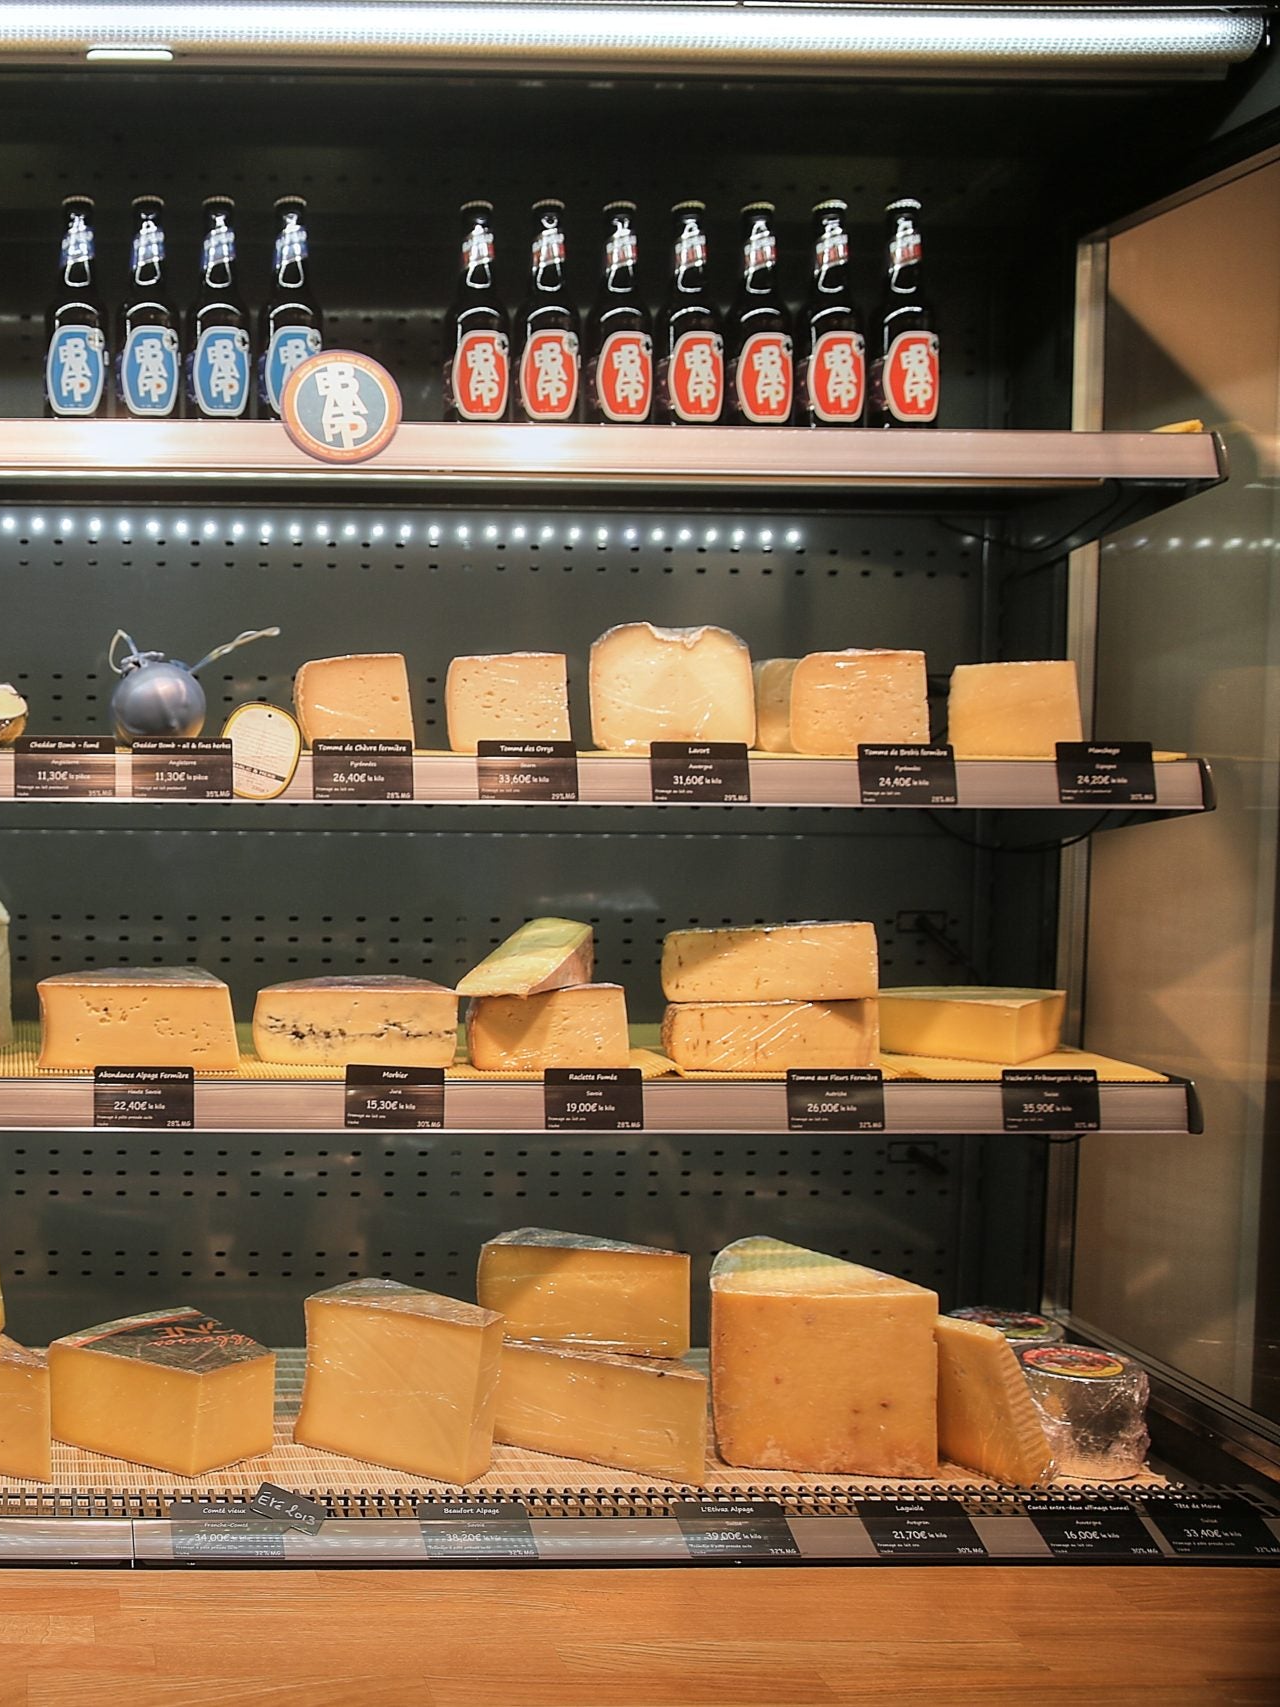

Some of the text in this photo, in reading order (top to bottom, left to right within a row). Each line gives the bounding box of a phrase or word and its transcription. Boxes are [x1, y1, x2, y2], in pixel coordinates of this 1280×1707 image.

[84, 741, 99, 749] fumé
[378, 744, 406, 752] fermière
[536, 745, 553, 753] Orrys
[38, 771, 68, 781] 11,30€
[155, 772, 185, 781] 11,30€
[333, 773, 366, 783] 26,40€
[499, 775, 531, 785] 33,60€
[673, 776, 704, 785] 31,60€
[1077, 776, 1110, 785] 24,20€
[879, 778, 911, 788] 24,40€
[136, 1072, 158, 1080] Alpage
[160, 1071, 189, 1079] Fermière
[114, 1101, 147, 1110] 22,40€
[367, 1100, 398, 1110] 15,30€
[567, 1103, 597, 1112] 19,00€
[808, 1104, 839, 1113] 26,00€
[1023, 1104, 1054, 1113] 35,90€
[731, 1506, 754, 1514] Alpage
[1084, 1505, 1108, 1513] affinage
[286, 1505, 315, 1525] 2013
[194, 1534, 229, 1543] 34,00€
[446, 1534, 481, 1542] 38,20€
[705, 1532, 741, 1541] 39,00€
[892, 1531, 927, 1540] 21,70€
[1064, 1531, 1100, 1540] 16,00€
[1184, 1529, 1221, 1539] 33,40€
